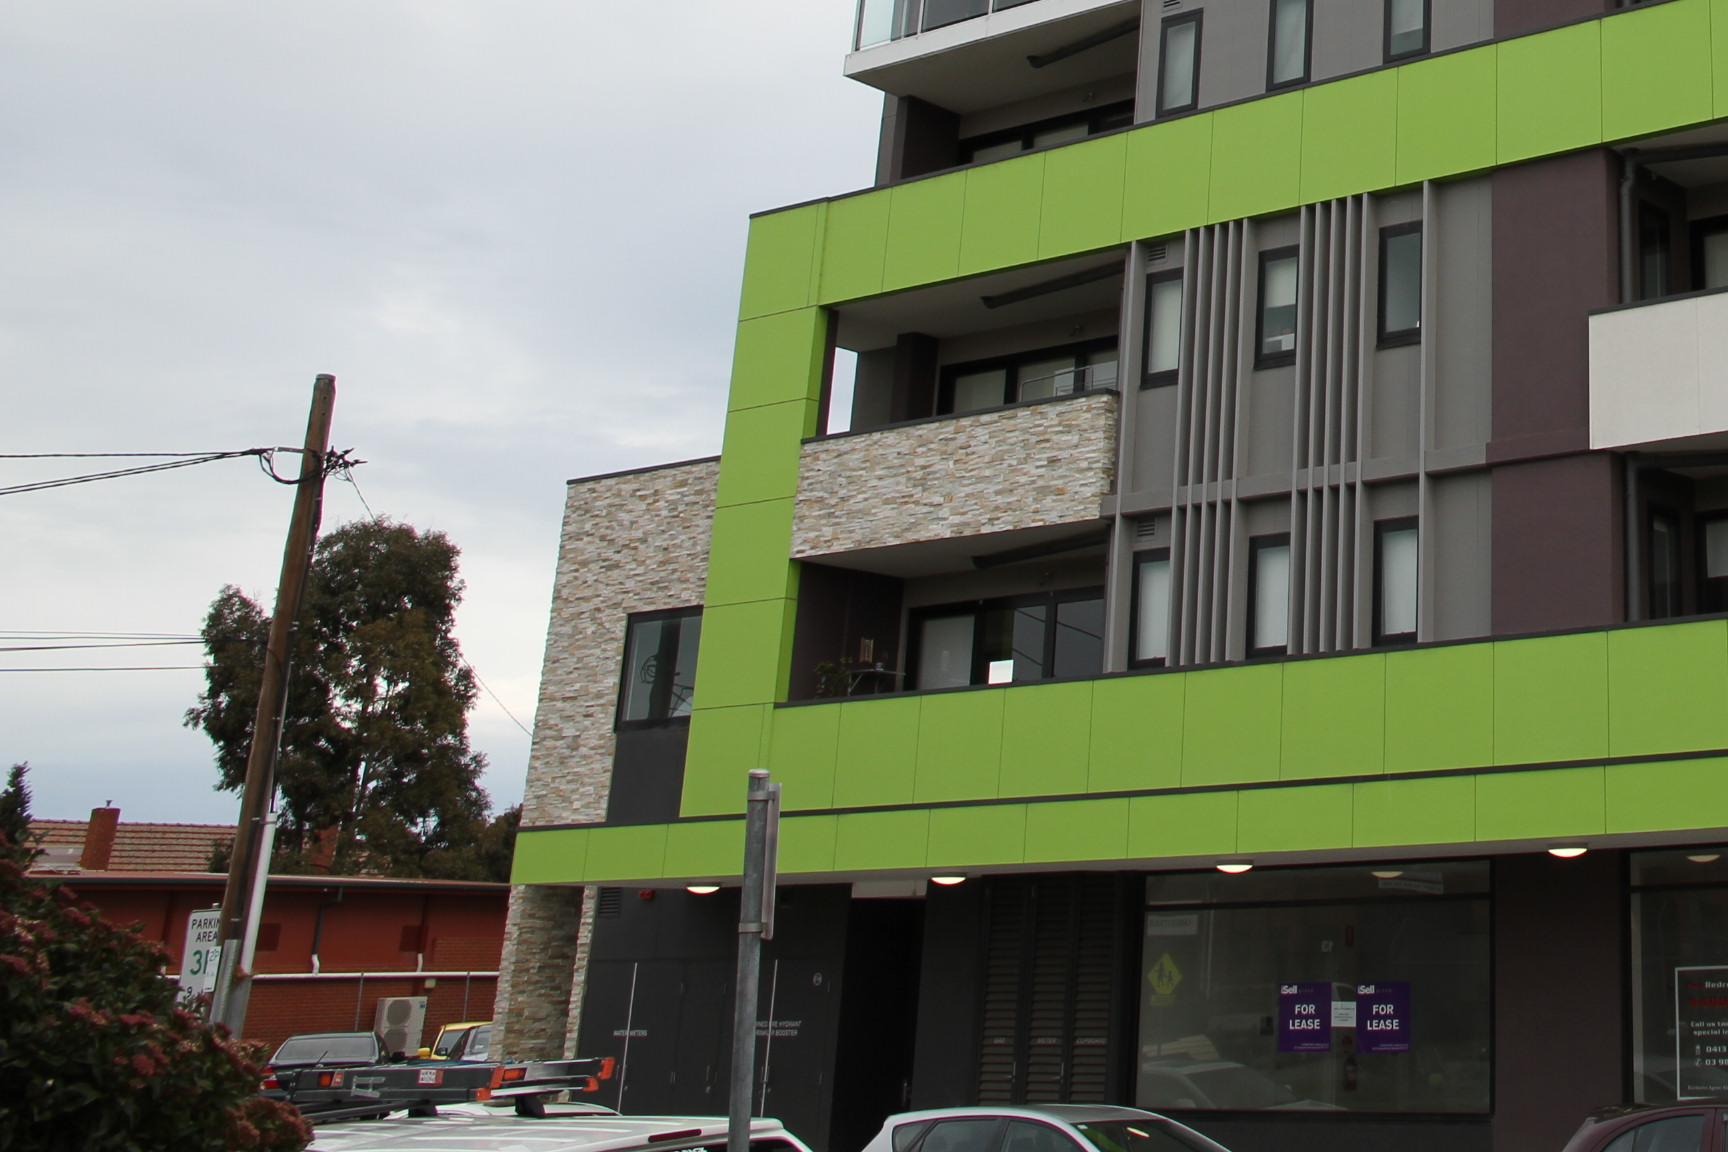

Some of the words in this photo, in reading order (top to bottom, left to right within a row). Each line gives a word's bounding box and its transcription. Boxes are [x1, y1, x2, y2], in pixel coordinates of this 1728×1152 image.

[191, 918, 221, 930] PARKIN
[195, 931, 218, 943] AREA
[1295, 1004, 1316, 1015] FOR
[1373, 1004, 1394, 1015] FOR
[1289, 1019, 1320, 1030] LEASE
[1367, 1019, 1399, 1030] LEASE
